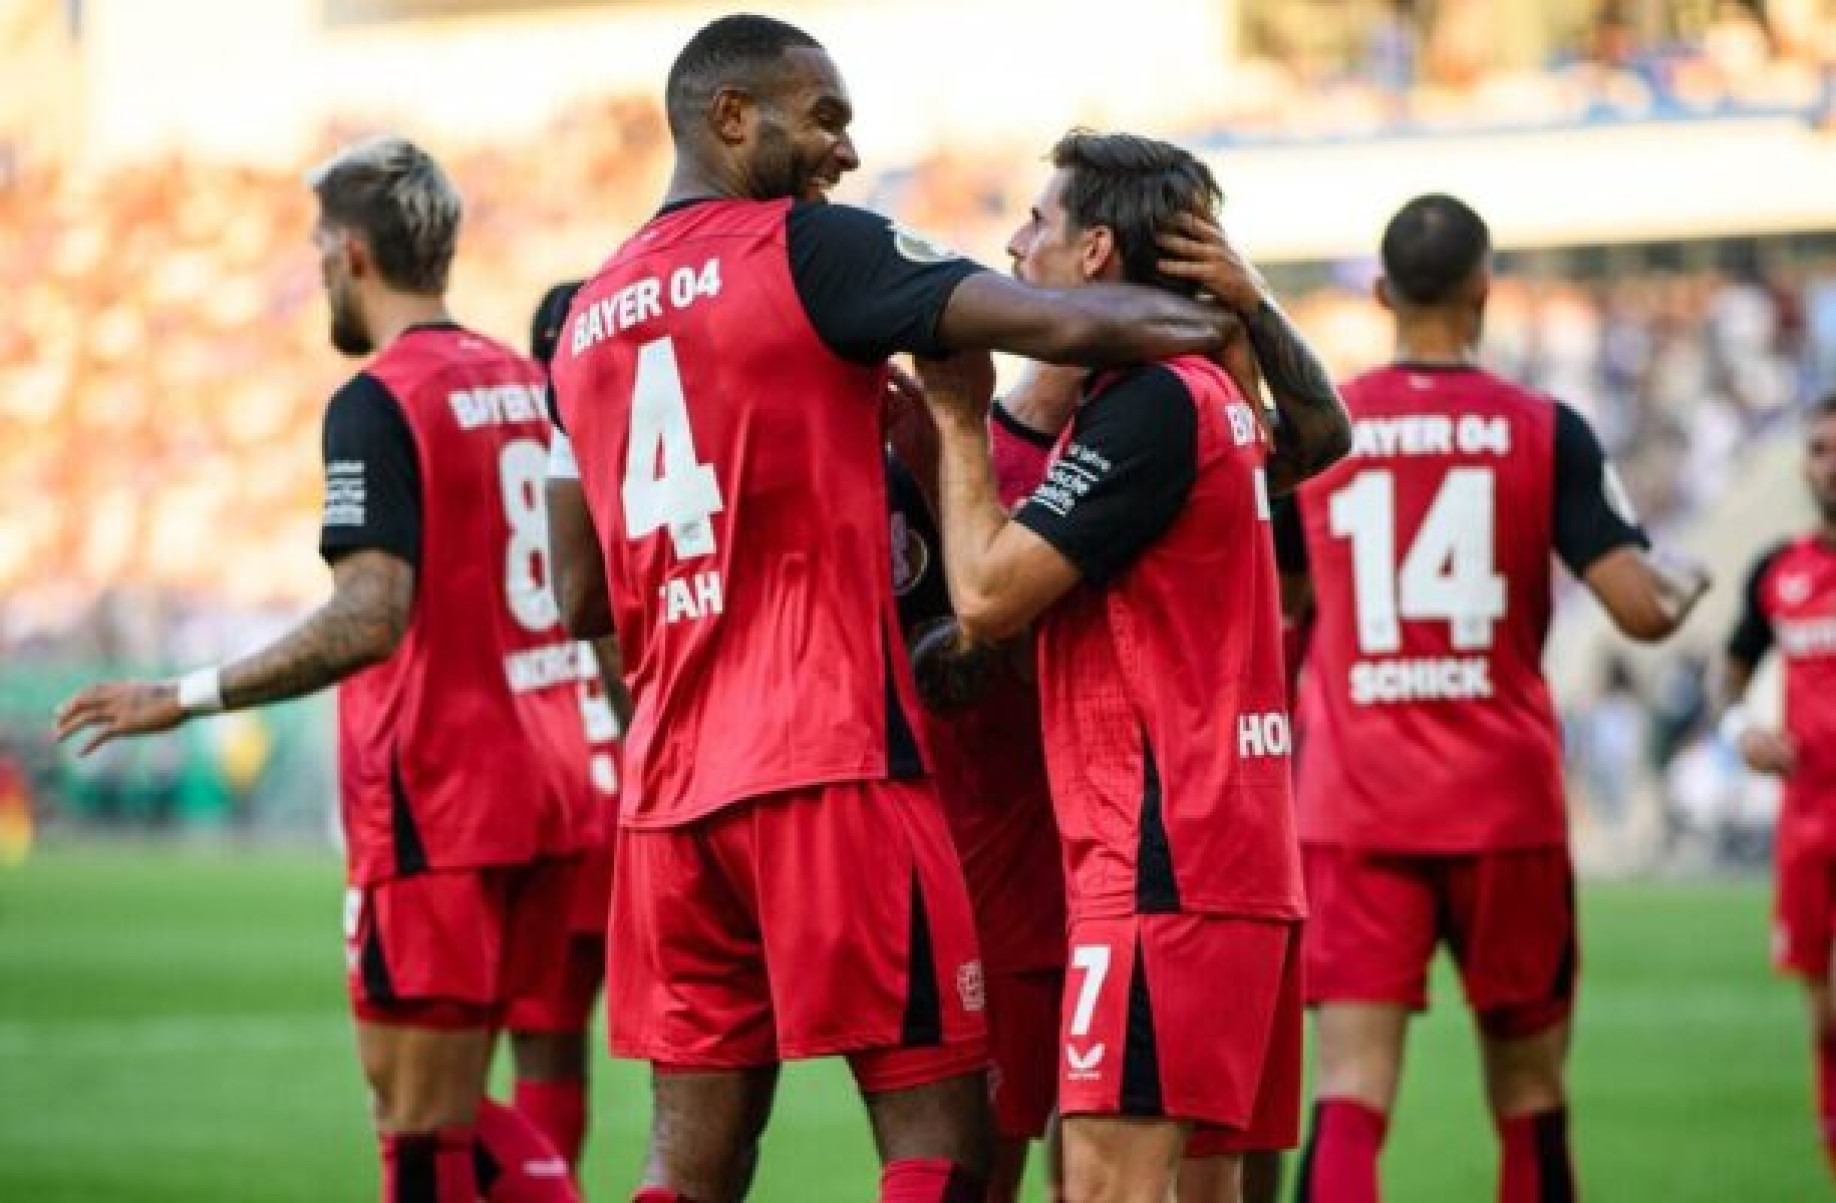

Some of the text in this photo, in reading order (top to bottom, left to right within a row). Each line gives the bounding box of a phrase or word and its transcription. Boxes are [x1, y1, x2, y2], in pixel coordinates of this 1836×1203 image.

[570, 257, 722, 356] BAYER 04
[622, 335, 724, 560] 4
[1351, 413, 1513, 457] AYER 04
[499, 438, 560, 633] 8
[1329, 466, 1510, 654] 14
[1348, 656, 1495, 706] SCHICK
[1071, 944, 1112, 1037] 7
